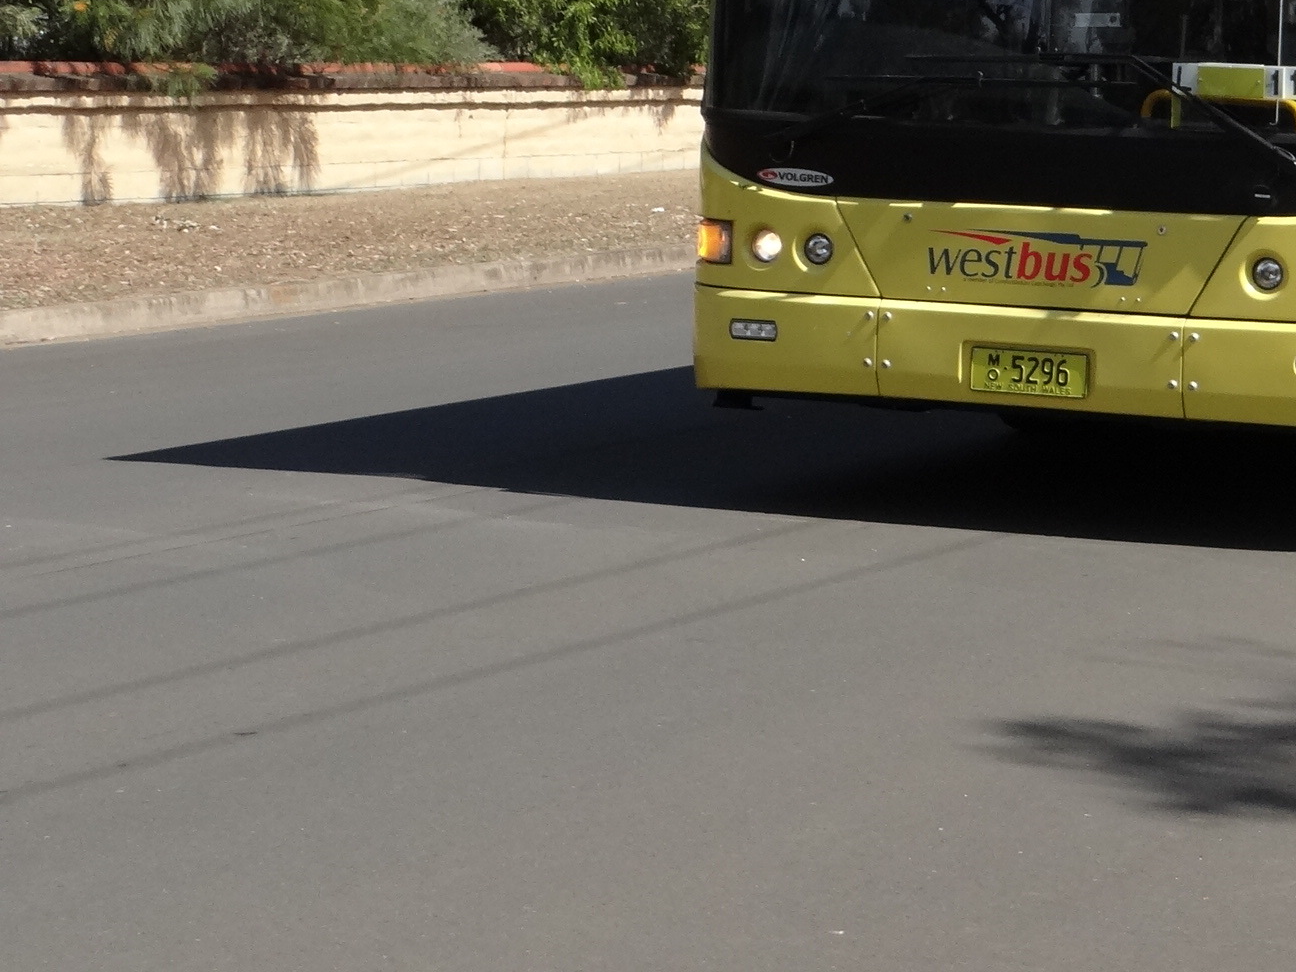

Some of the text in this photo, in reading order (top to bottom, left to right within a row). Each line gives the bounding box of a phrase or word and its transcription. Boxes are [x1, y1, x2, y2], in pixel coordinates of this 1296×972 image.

[778, 171, 828, 184] VOLGREN
[928, 241, 1094, 283] westbus
[1012, 355, 1070, 386] 5296
[984, 381, 1072, 395] NEW SOUTH WALES
